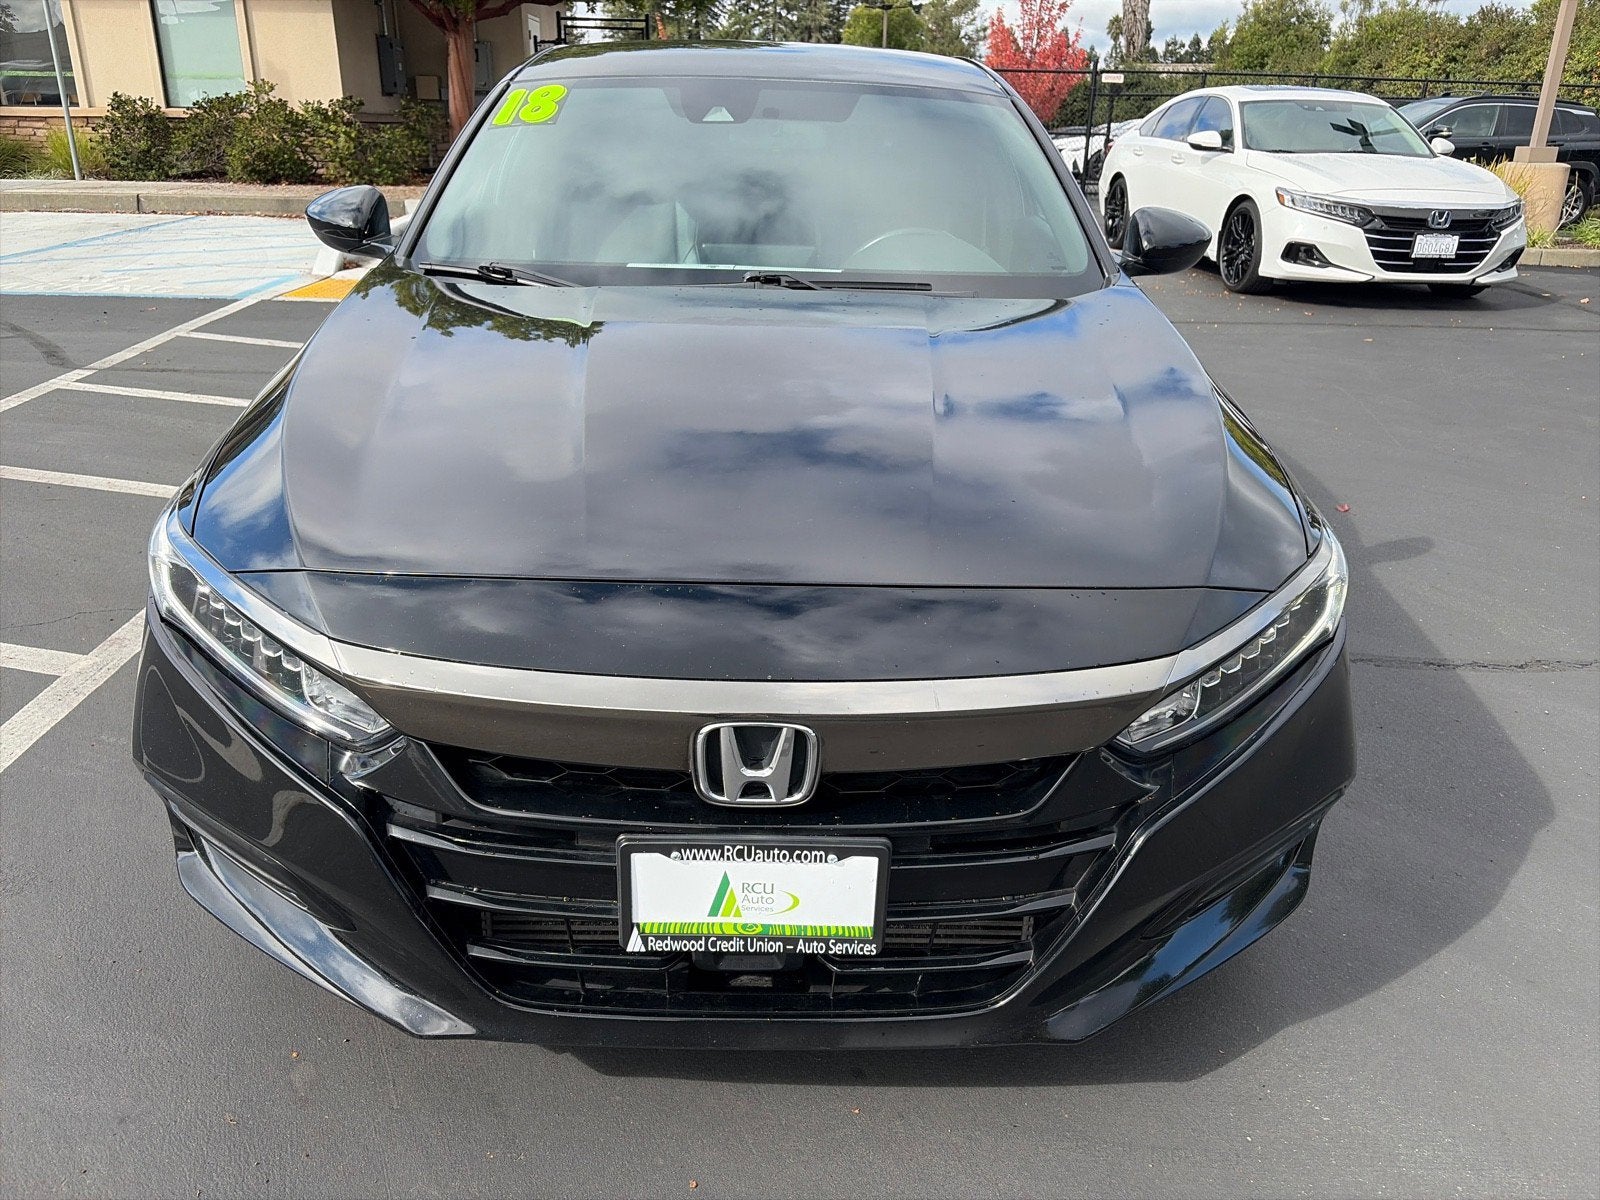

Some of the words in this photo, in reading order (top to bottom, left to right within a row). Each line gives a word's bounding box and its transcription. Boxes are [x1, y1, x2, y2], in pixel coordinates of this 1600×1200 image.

[492, 84, 568, 126] 18
[681, 845, 826, 864] www.RCUauto.com
[741, 882, 775, 894] RCU
[741, 894, 775, 905] Auto
[741, 904, 775, 912] Services
[648, 937, 705, 952] Redwood
[707, 937, 745, 952] Credit
[747, 937, 784, 953] Union
[796, 939, 828, 954] Auto
[829, 938, 877, 955] Services
